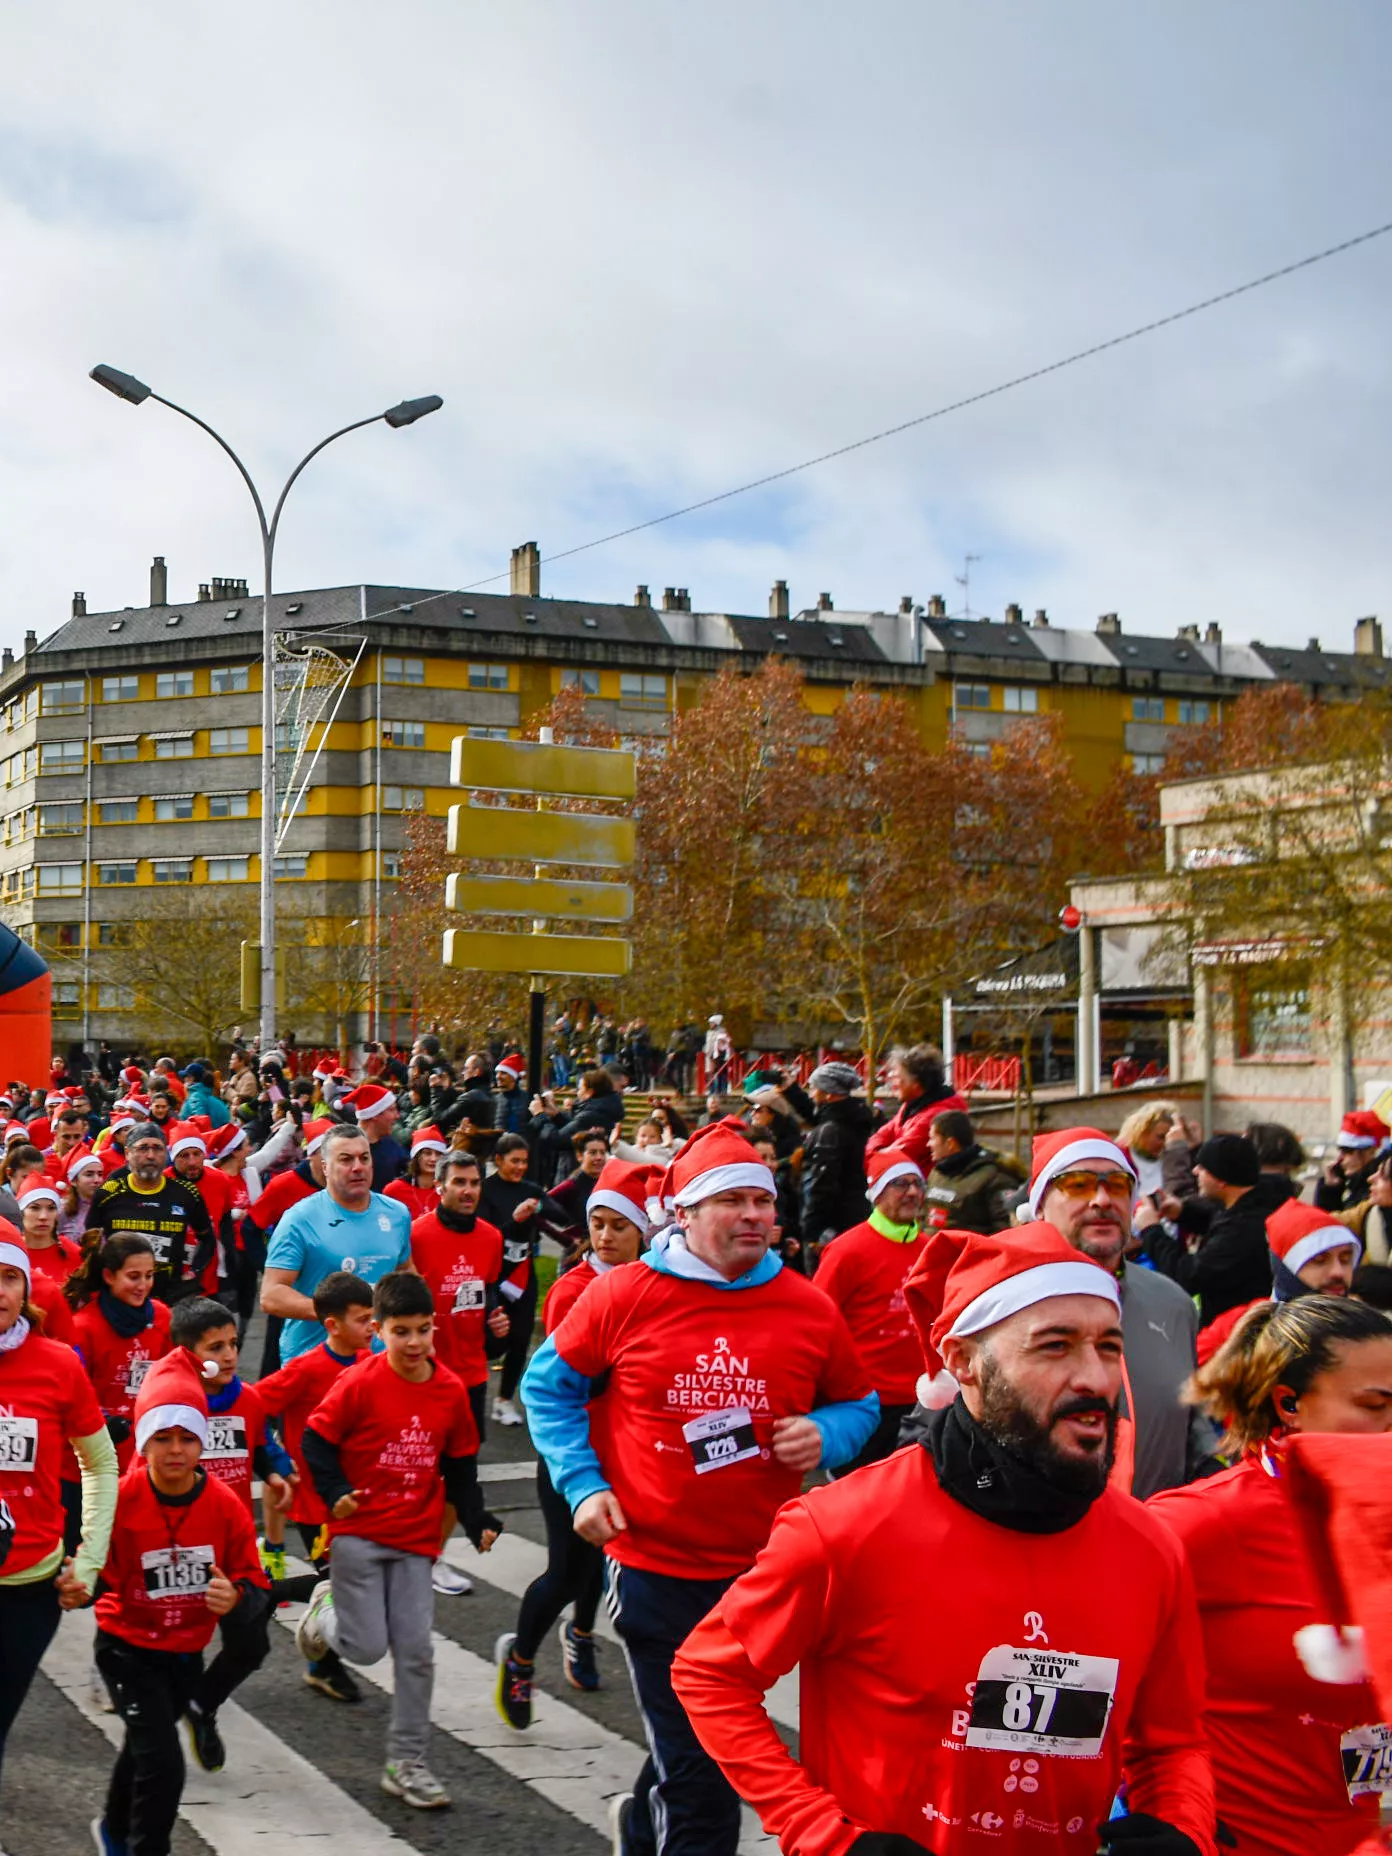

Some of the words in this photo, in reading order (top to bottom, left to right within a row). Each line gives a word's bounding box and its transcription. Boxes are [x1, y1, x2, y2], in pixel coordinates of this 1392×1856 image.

[696, 1354, 749, 1376] SAN
[674, 1373, 766, 1394] SILVESTRE
[667, 1389, 770, 1410] BERCIANA
[400, 1429, 431, 1443] SAN
[154, 1563, 206, 1588] 1136
[1028, 1663, 1067, 1679] XLIV
[1034, 1655, 1080, 1667] SILVESTRE
[1003, 1683, 1057, 1733] 87
